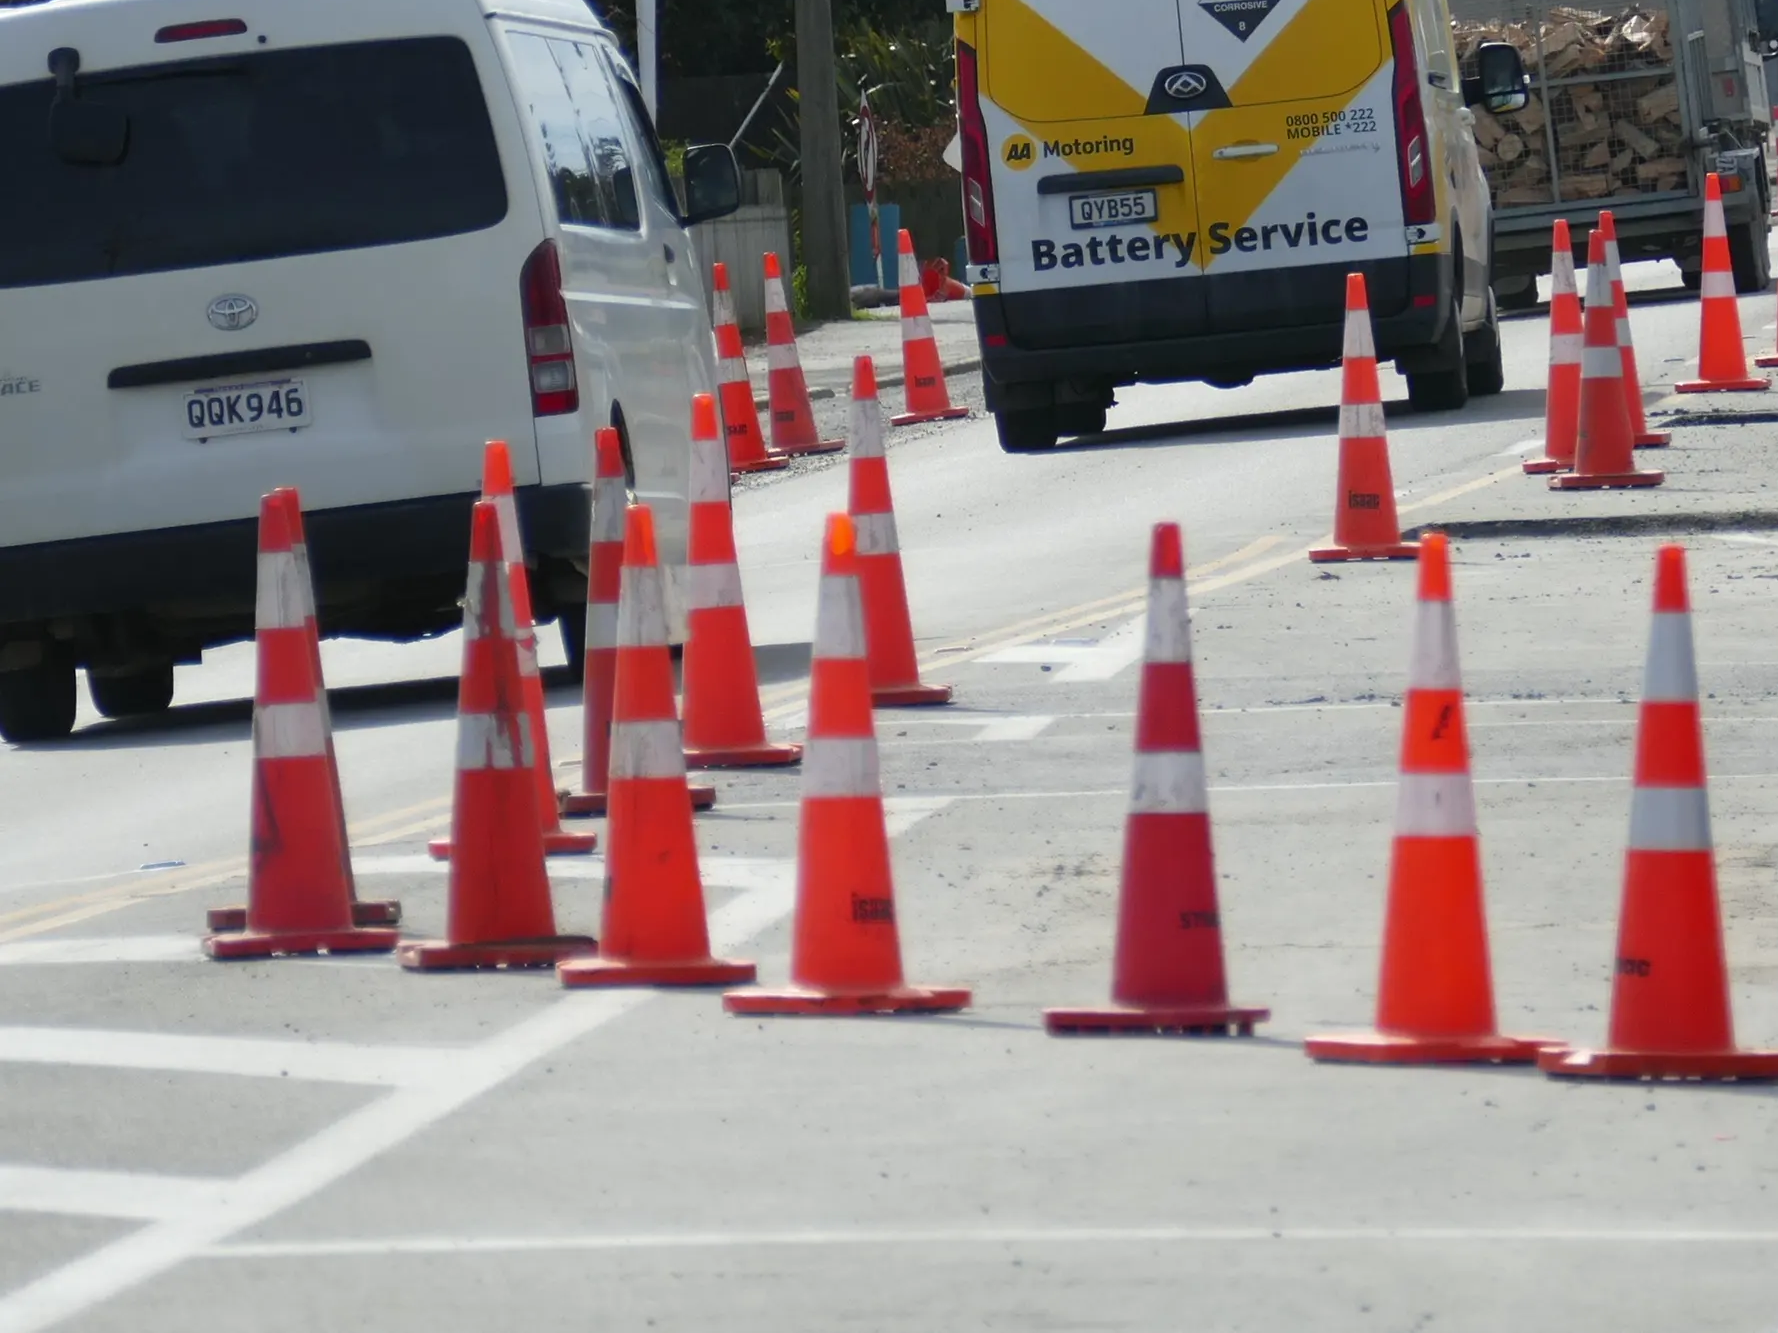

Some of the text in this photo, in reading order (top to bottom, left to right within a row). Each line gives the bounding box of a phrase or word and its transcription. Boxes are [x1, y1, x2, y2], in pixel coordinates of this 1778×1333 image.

[1214, 0, 1268, 12] CORROSIVE
[1238, 21, 1246, 31] 8
[1286, 108, 1374, 127] 0800 500 222
[1286, 124, 1341, 139] MOBILE
[1006, 136, 1134, 161] AA Motoring
[1081, 196, 1146, 221] QYB55
[1031, 212, 1369, 272] Battery Service
[187, 388, 303, 428] QQK946
